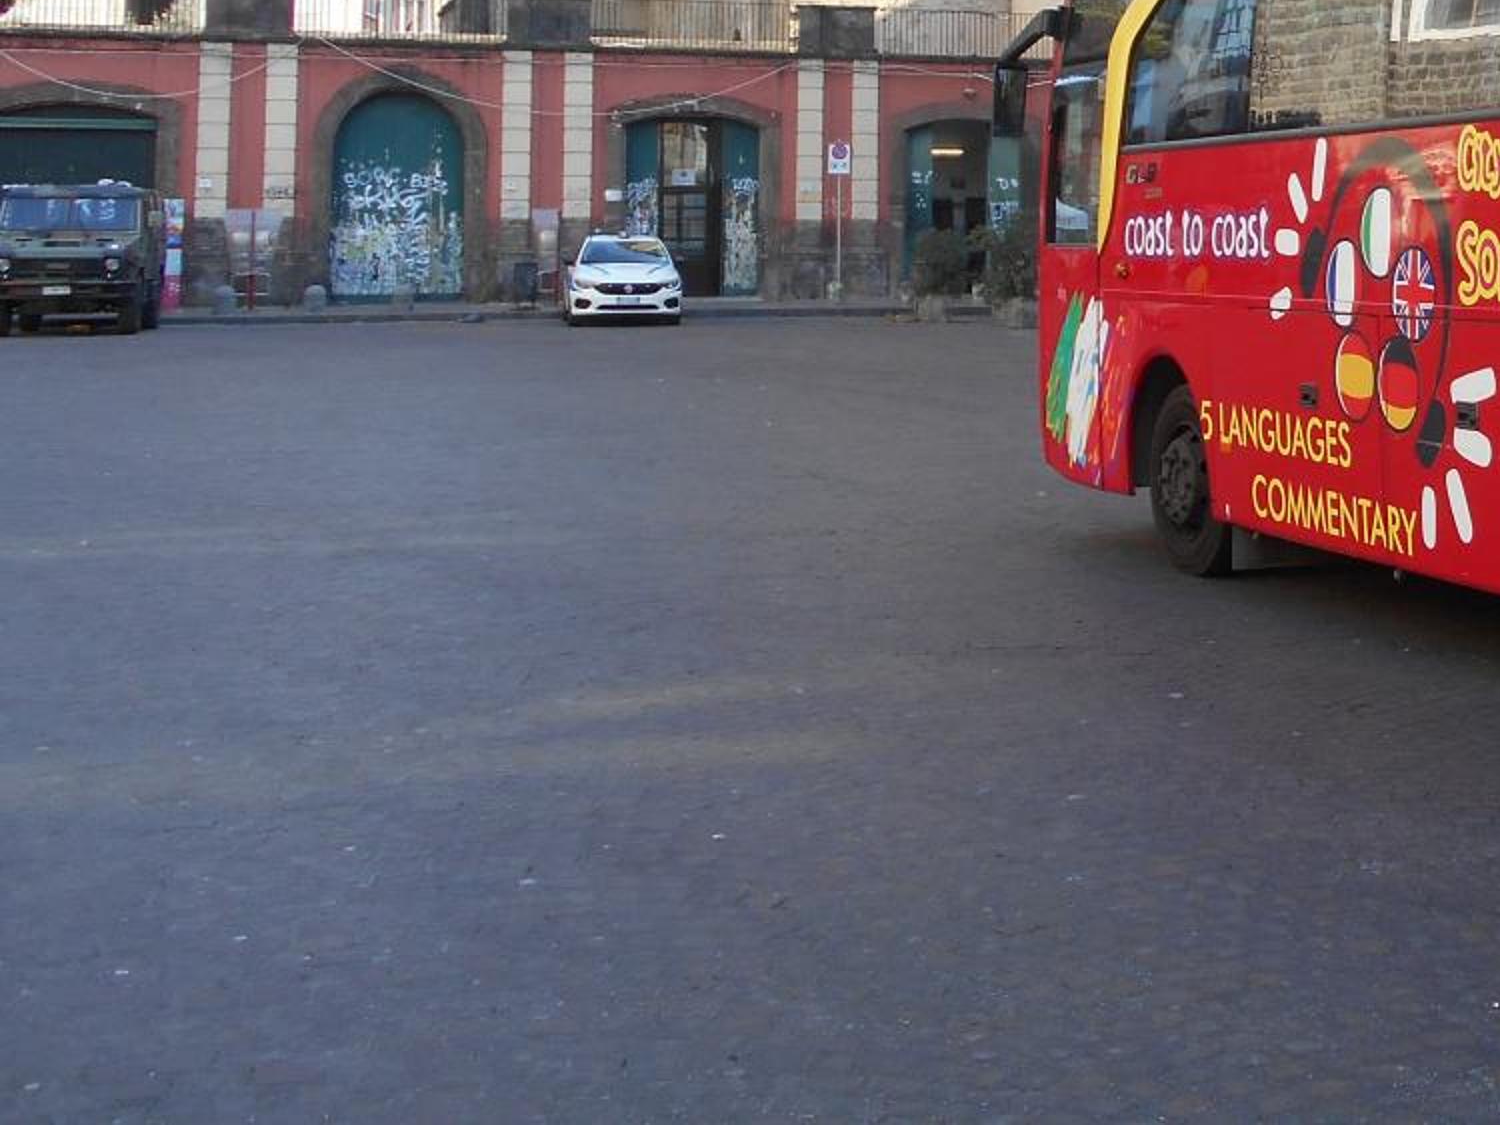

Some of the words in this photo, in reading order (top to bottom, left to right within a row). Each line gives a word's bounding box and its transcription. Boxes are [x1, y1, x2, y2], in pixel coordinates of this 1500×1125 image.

[1125, 210, 1174, 256] coast
[1182, 209, 1204, 256] to
[1211, 207, 1270, 258] coast
[1200, 400, 1213, 441] 5
[1219, 402, 1351, 468] LANGUAGES
[1252, 474, 1417, 556] COMMENTARY
